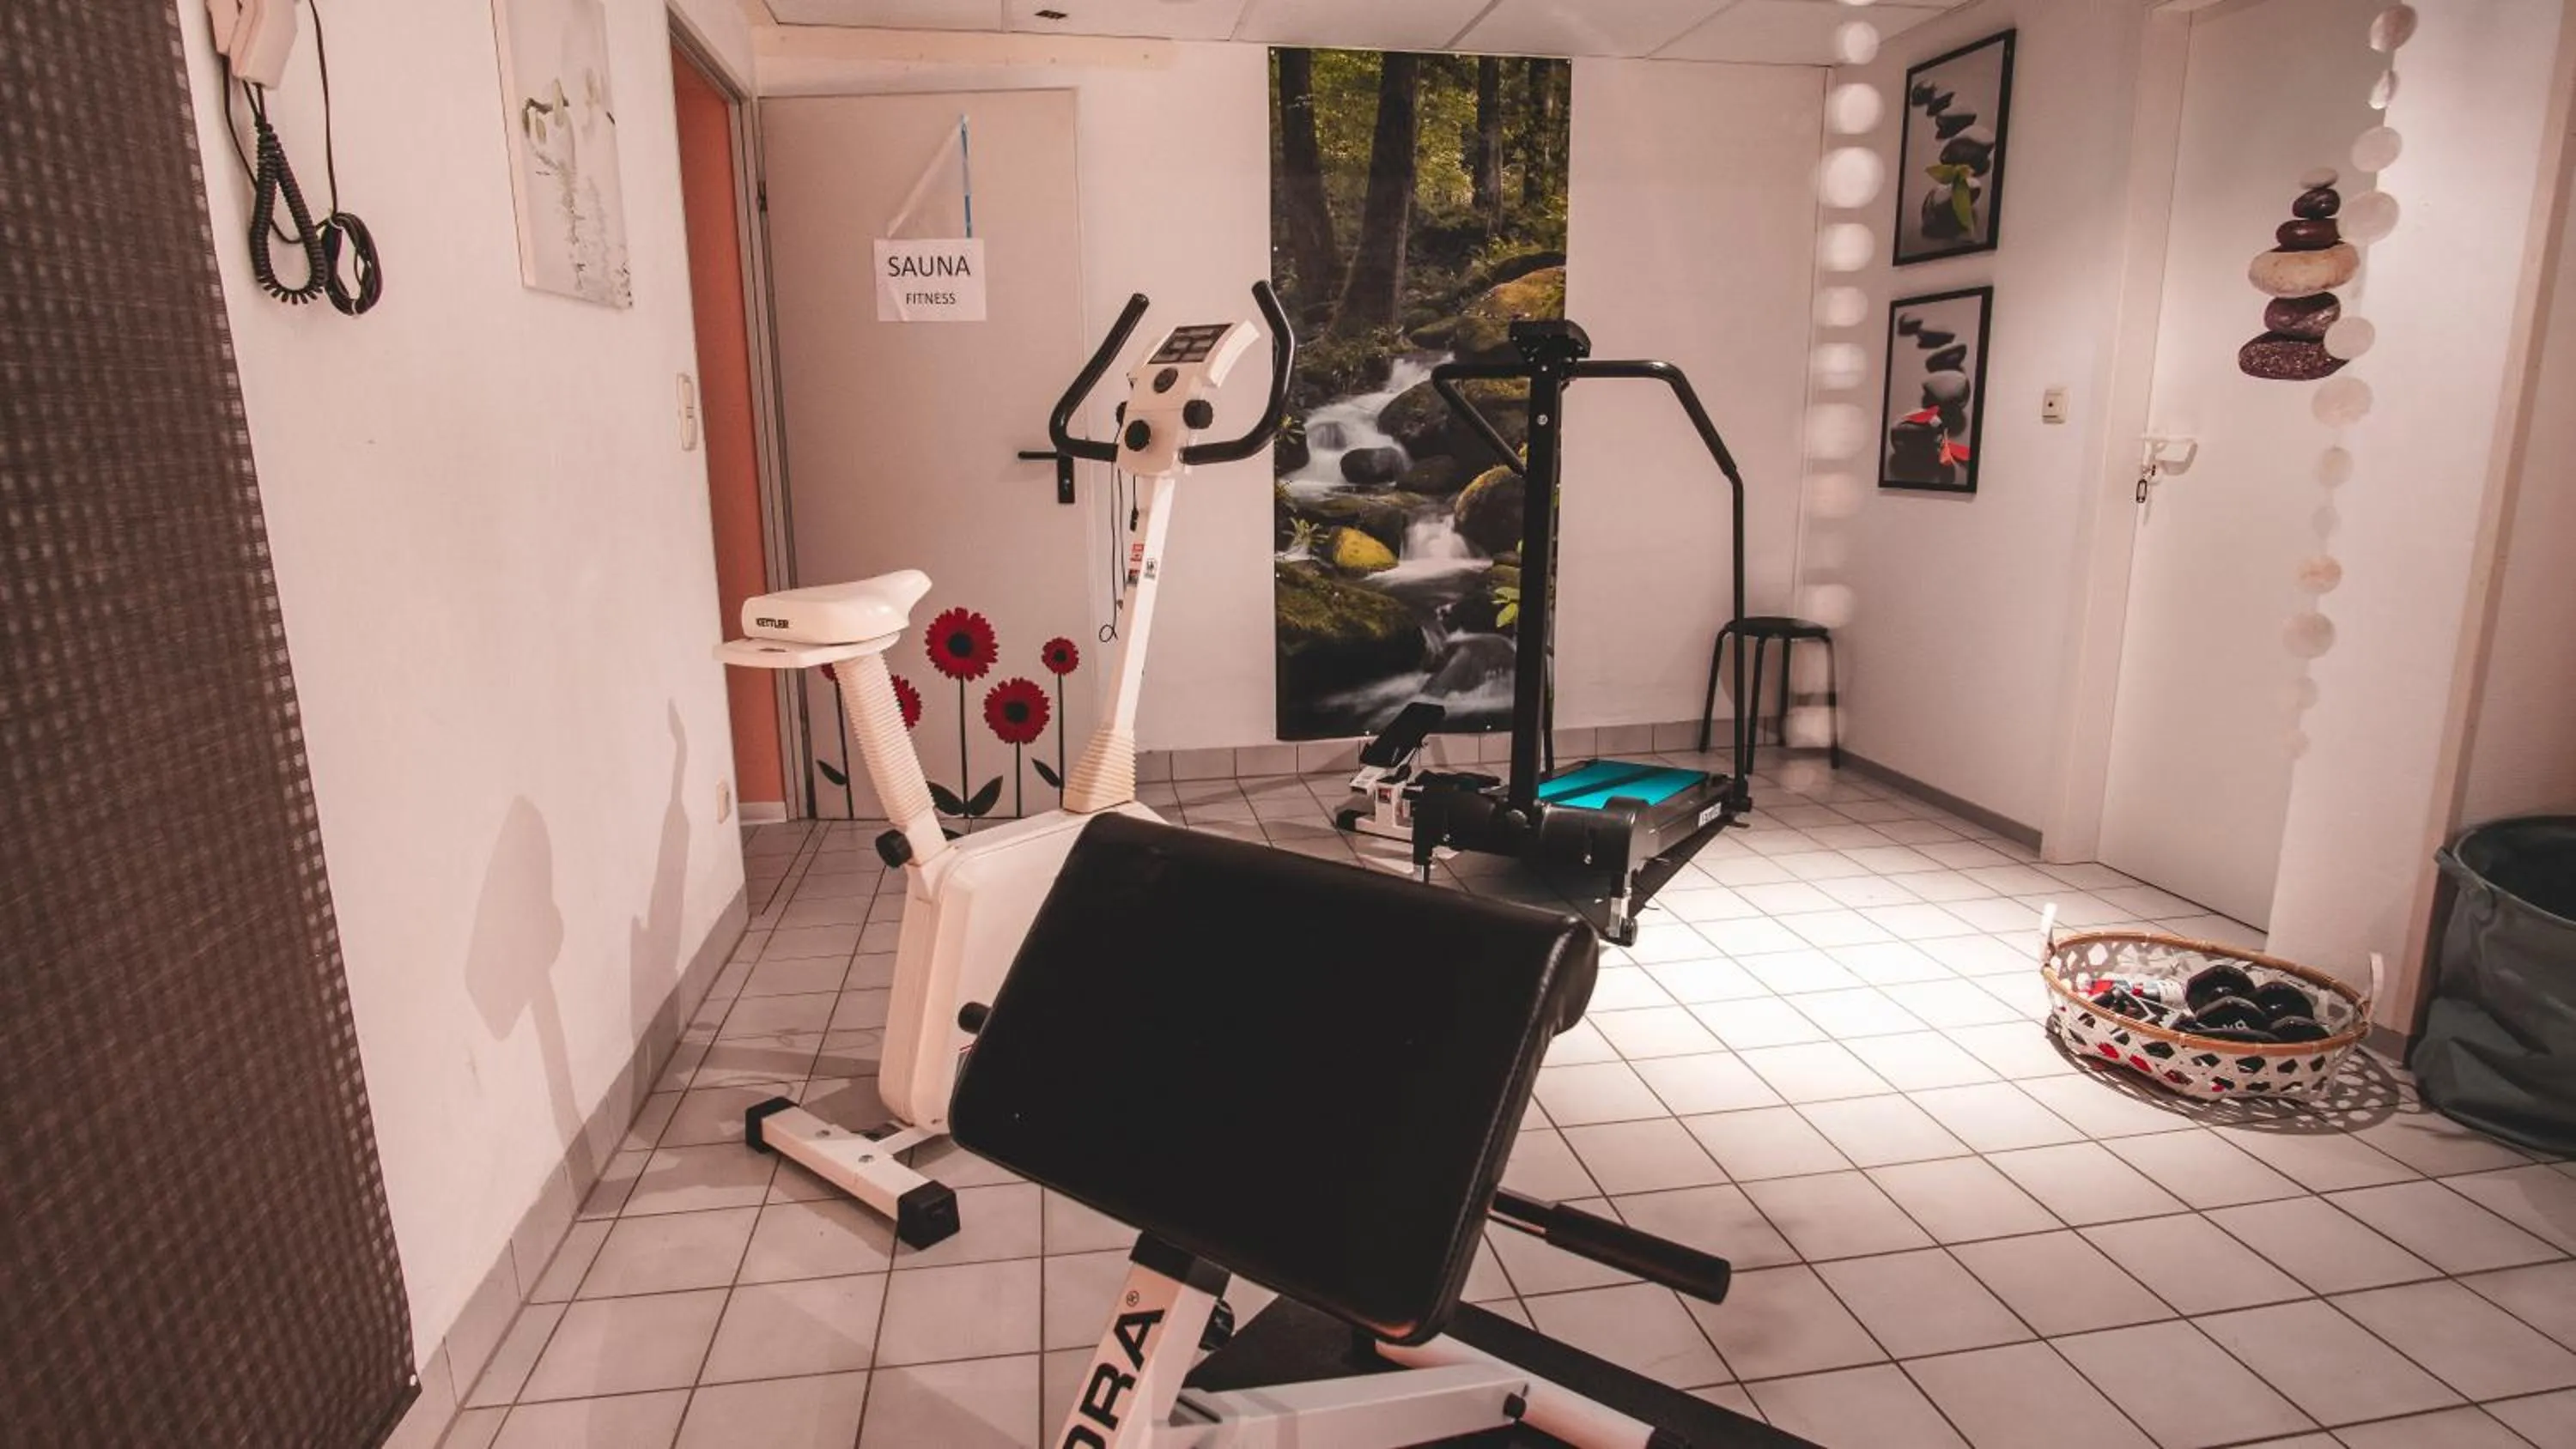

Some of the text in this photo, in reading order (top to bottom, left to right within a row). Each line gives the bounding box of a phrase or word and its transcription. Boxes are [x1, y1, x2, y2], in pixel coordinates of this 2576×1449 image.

[887, 255, 971, 278] SAUNA
[906, 293, 957, 305] FITNESS
[756, 617, 789, 629] KETTLER
